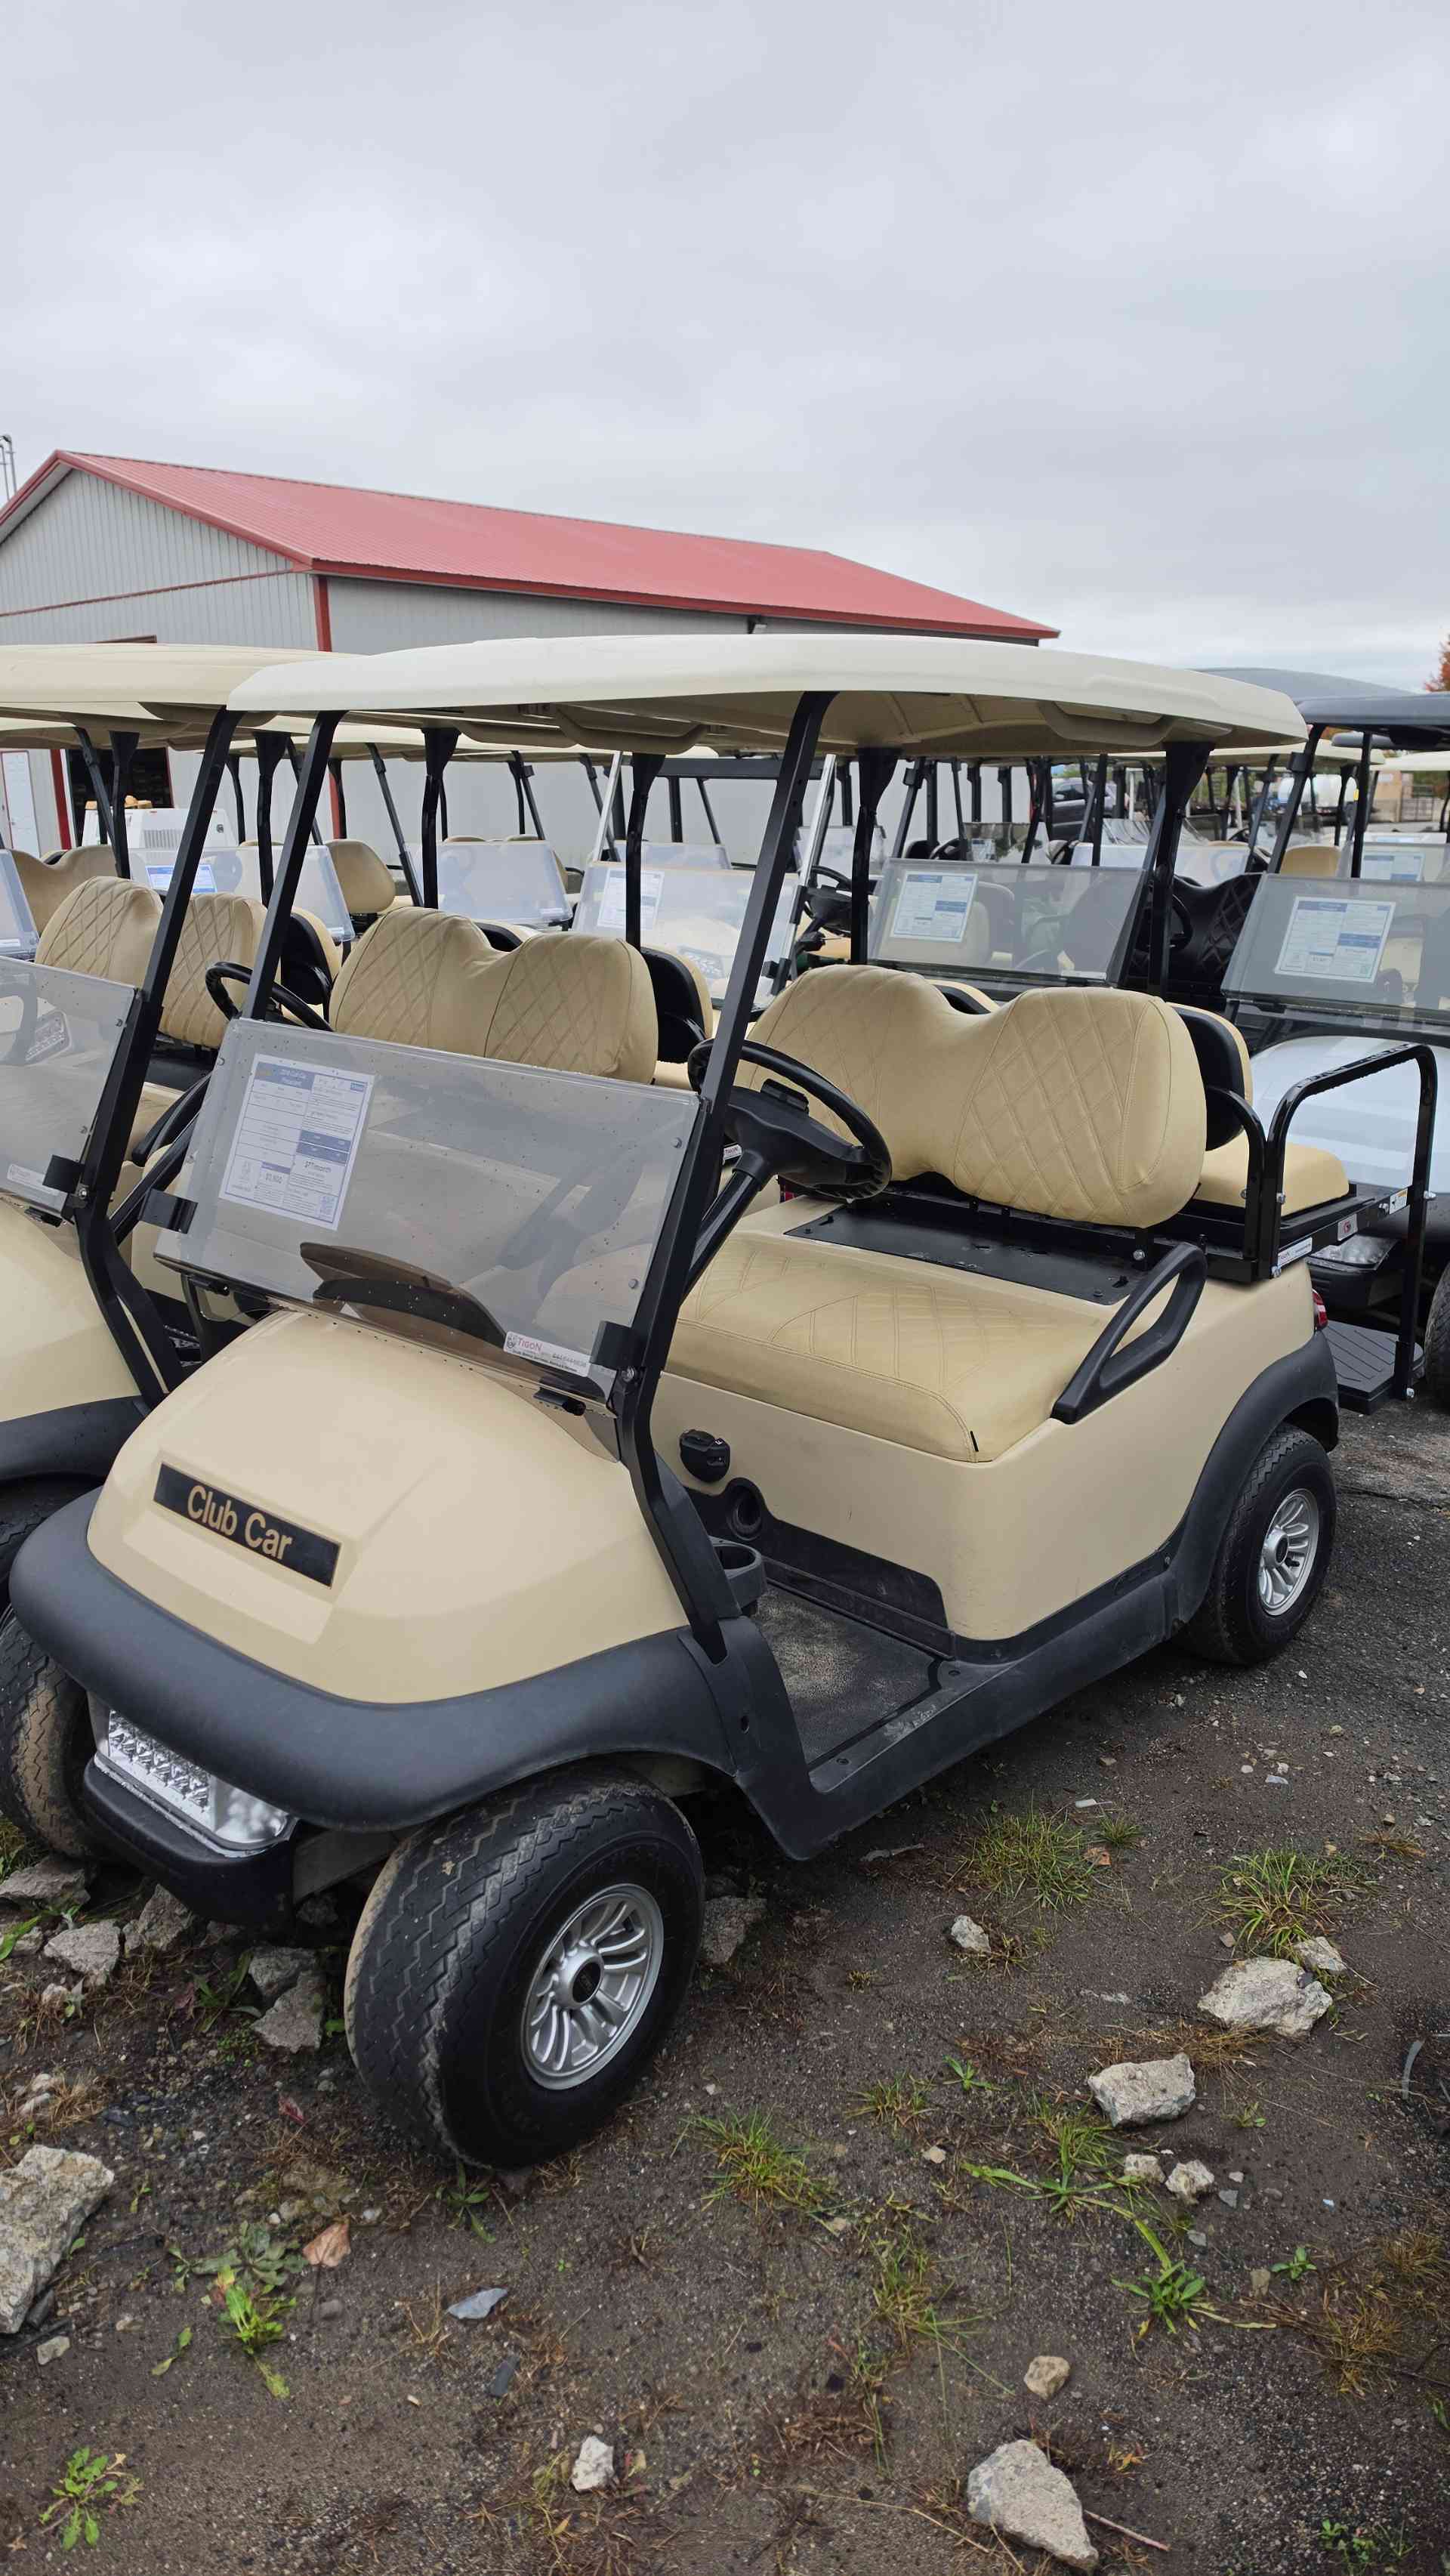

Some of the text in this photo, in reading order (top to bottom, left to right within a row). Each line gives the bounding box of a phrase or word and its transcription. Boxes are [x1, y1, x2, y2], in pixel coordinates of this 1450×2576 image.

[518, 1338, 542, 1351] TIGON
[187, 1485, 294, 1560] Club Car
